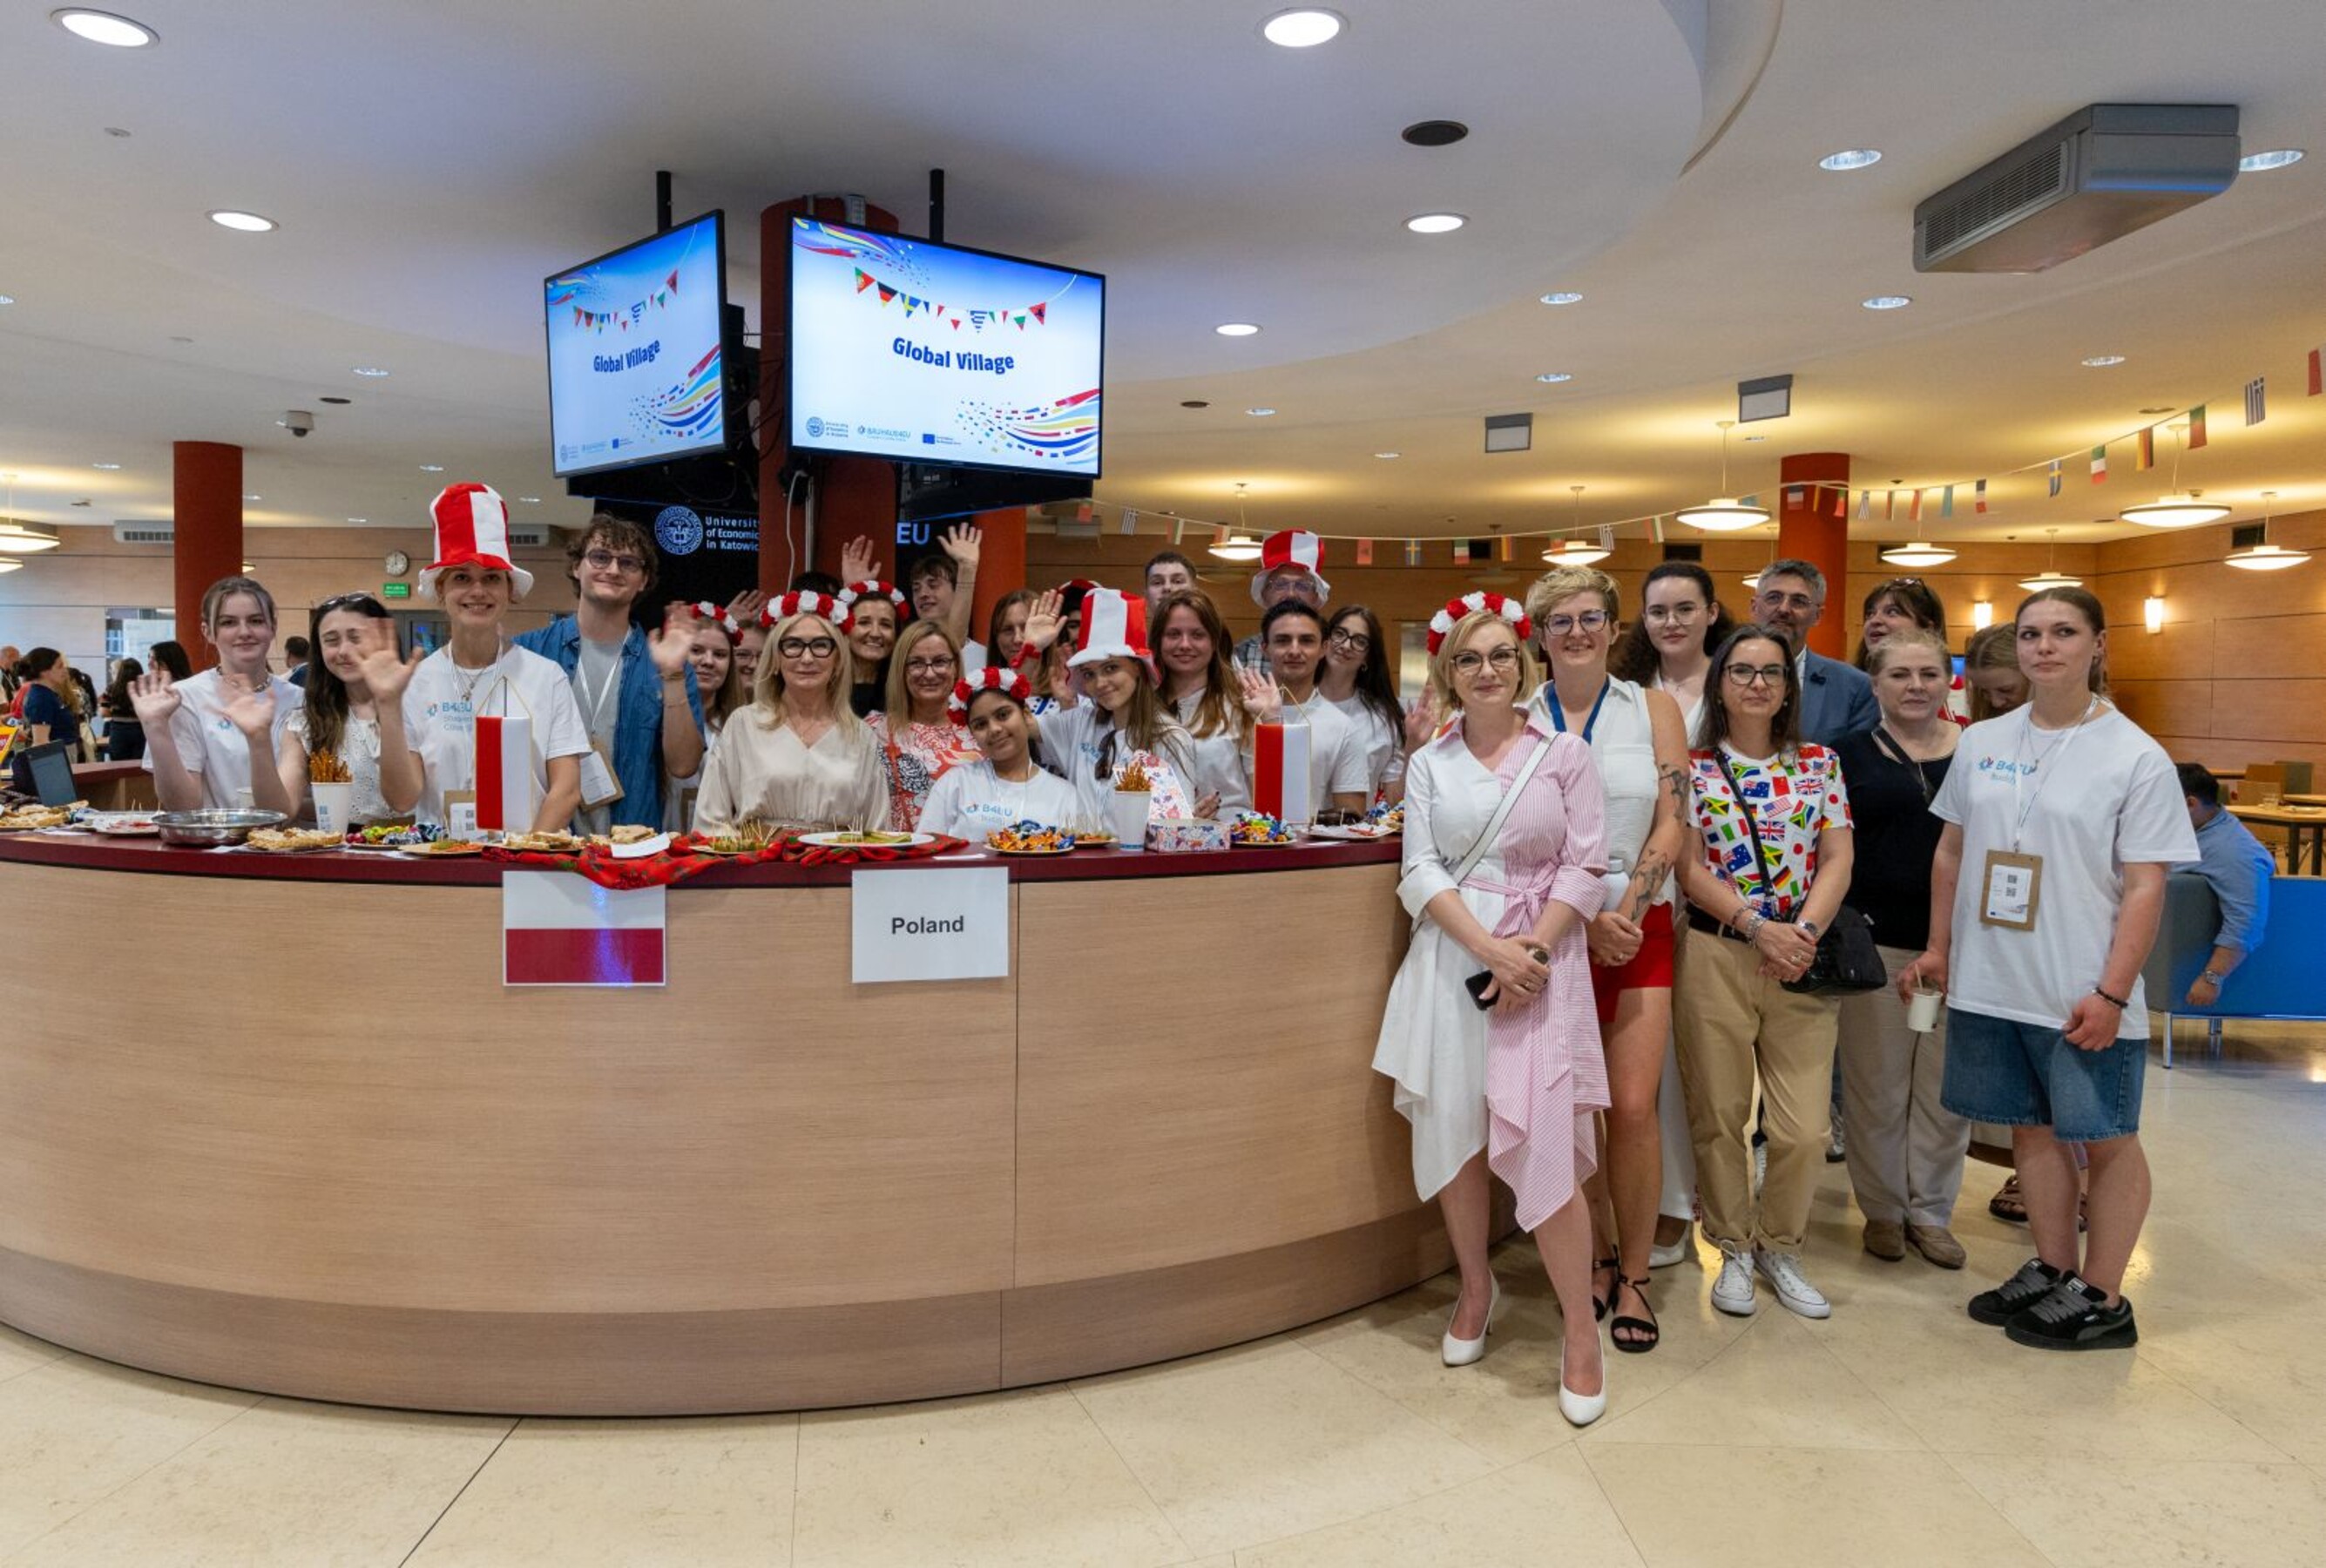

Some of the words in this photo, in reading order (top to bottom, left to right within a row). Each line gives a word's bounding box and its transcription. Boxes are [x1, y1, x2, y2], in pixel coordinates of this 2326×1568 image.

[593, 355, 624, 373] Global
[625, 340, 660, 369] Village
[892, 337, 950, 368] Global
[956, 352, 1015, 375] Village
[705, 516, 761, 528] Universit
[706, 528, 716, 537] of
[718, 528, 761, 540] Economic
[707, 540, 716, 549] in
[720, 540, 761, 551] Katowic
[891, 915, 964, 935] Poland
